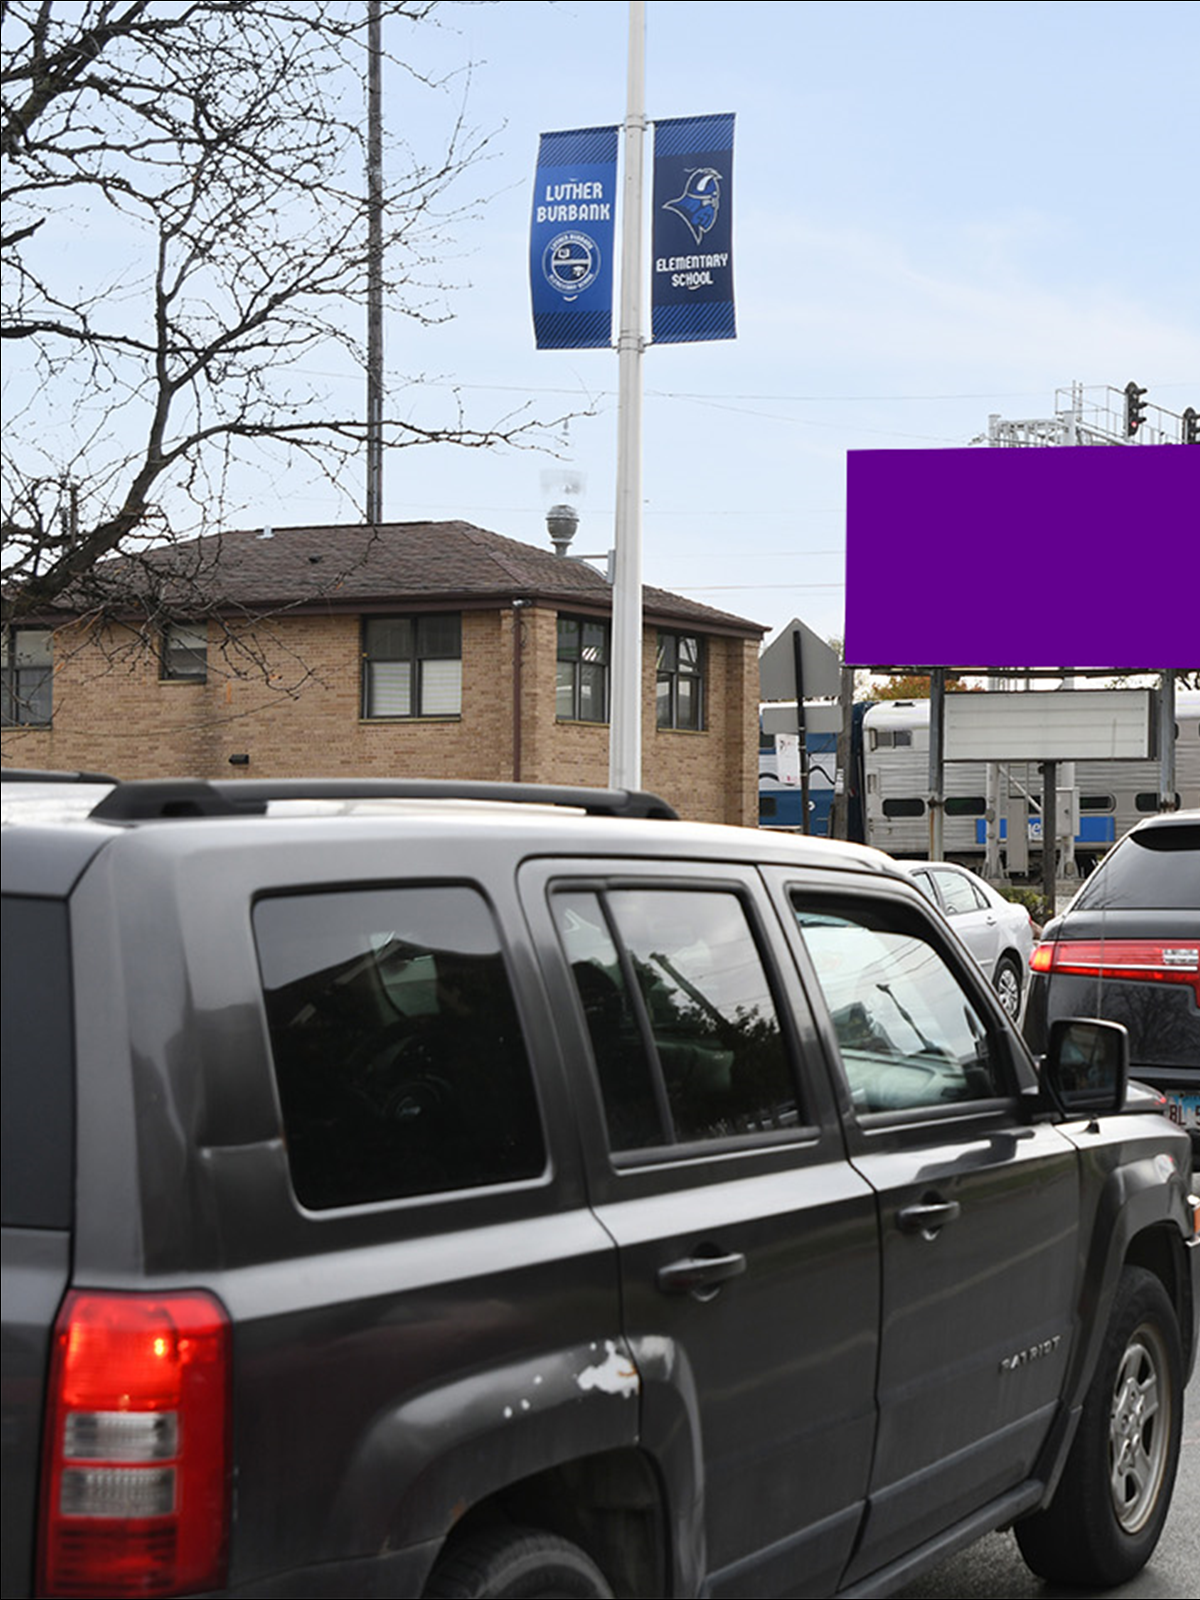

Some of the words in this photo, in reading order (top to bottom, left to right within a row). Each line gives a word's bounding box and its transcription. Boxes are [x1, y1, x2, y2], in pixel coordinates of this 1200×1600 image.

[546, 182, 603, 202] LUTHER
[537, 203, 611, 223] BURBANK
[656, 253, 728, 272] ELEMENTARY
[671, 271, 714, 287] SCHOOL
[999, 1335, 1061, 1372] PATRIOT
